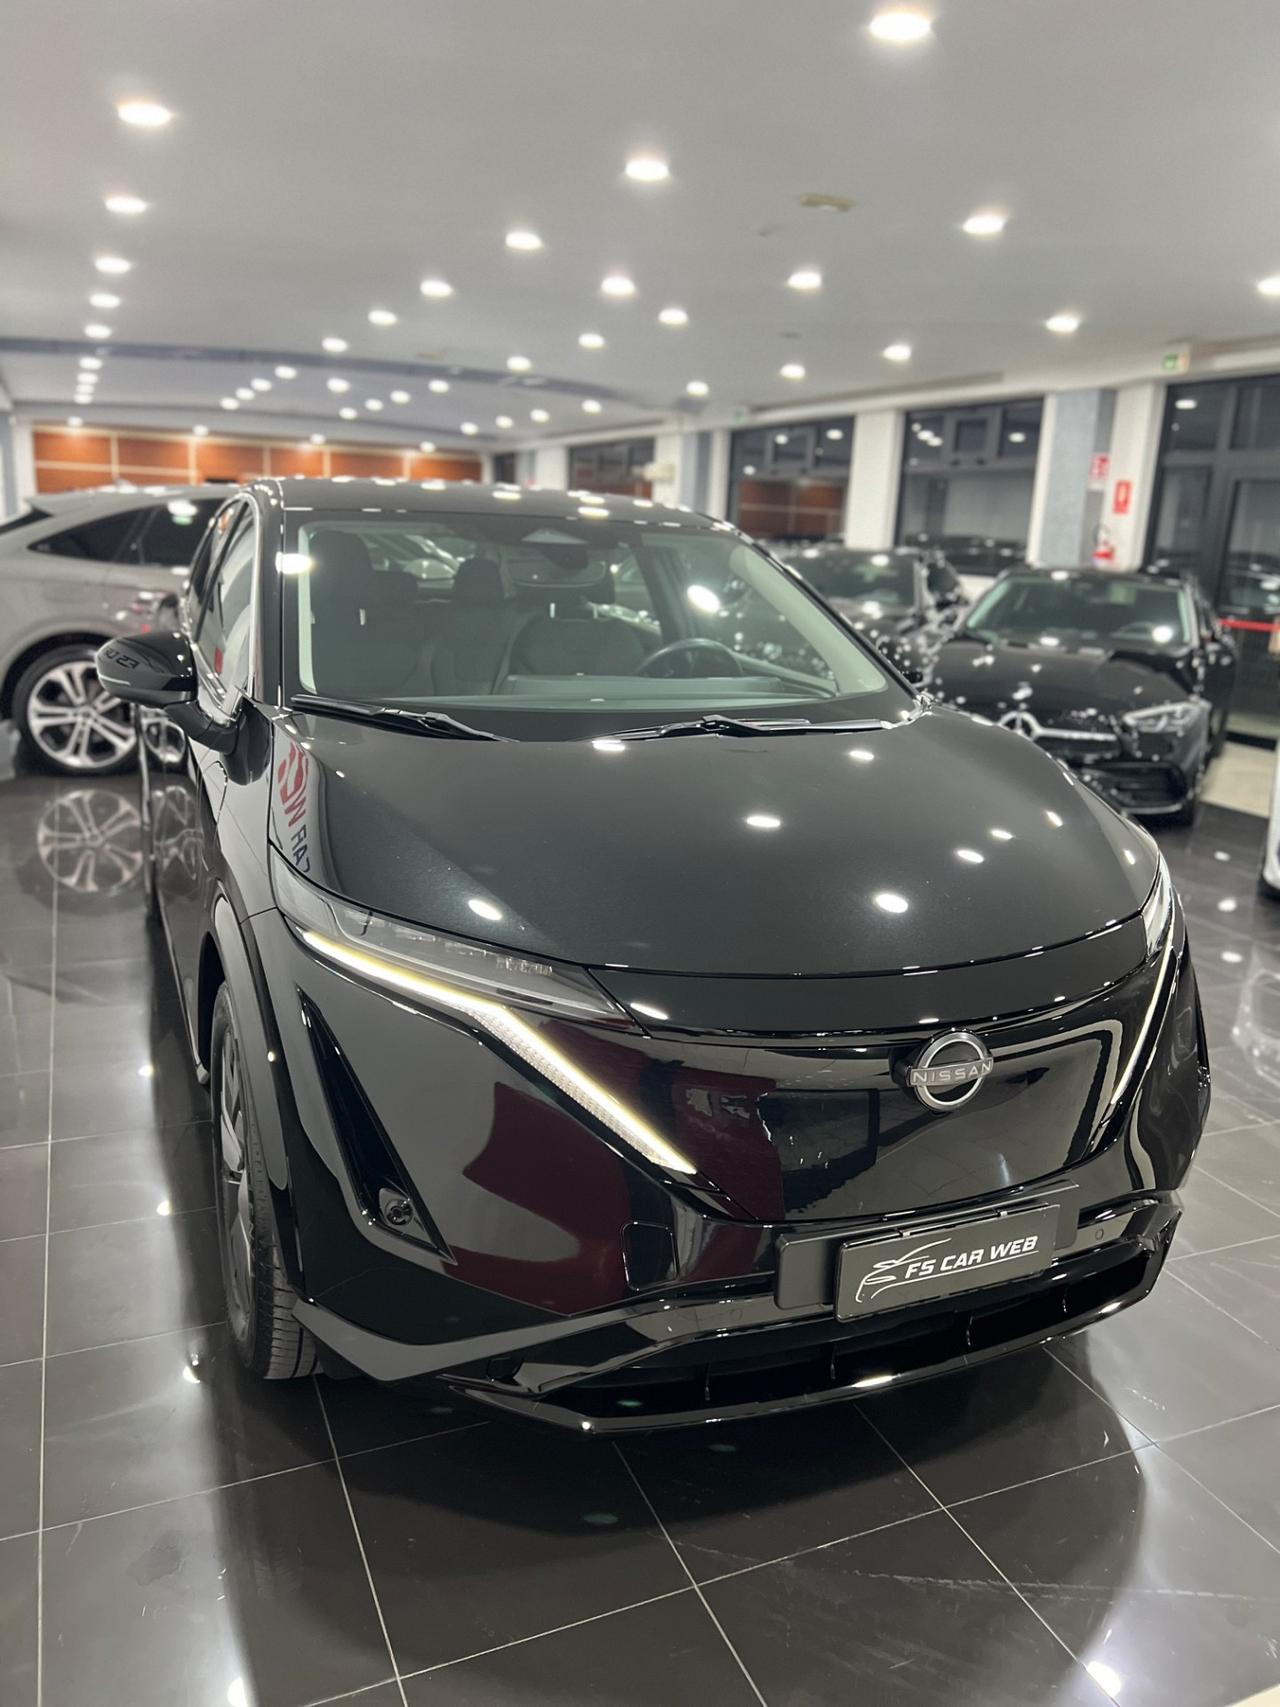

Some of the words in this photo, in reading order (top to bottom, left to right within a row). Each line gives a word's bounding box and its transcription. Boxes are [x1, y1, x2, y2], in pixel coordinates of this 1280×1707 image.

[912, 1060, 992, 1083] NISSAN
[904, 1258, 937, 1280] FS
[939, 1248, 985, 1272] CAR
[990, 1235, 1039, 1260] WEB
